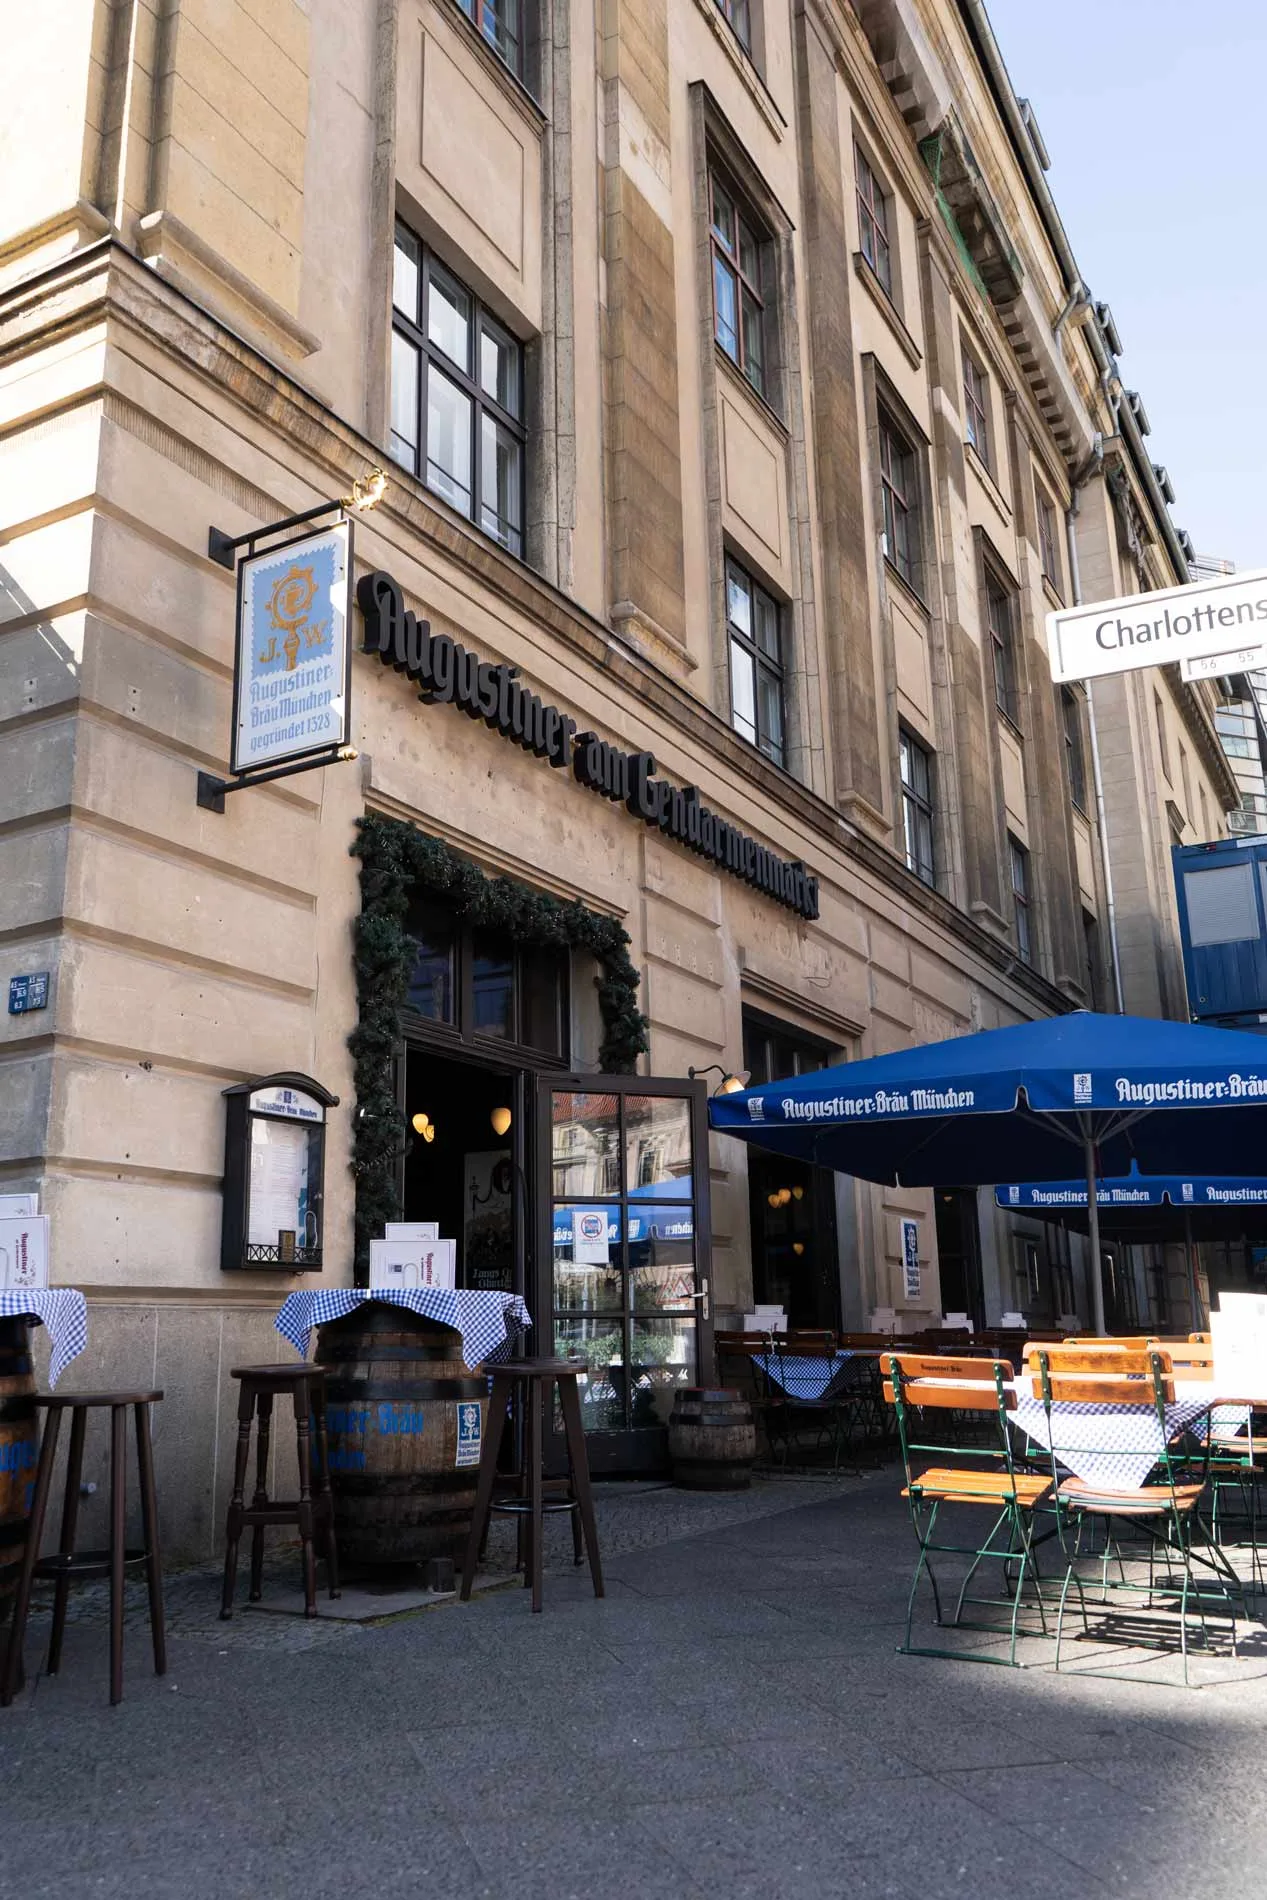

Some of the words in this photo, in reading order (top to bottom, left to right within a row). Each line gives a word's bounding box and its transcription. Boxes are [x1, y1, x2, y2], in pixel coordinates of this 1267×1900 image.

[1200, 657, 1217, 669] 56
[1238, 652, 1255, 664] 55
[250, 721, 305, 751] gegründet
[306, 712, 331, 734] 1328
[357, 570, 577, 768] Augustiner
[573, 731, 631, 801] am
[627, 751, 820, 920] Gendarmenmarkt
[910, 1088, 975, 1111] München
[1111, 1189, 1150, 1201] München
